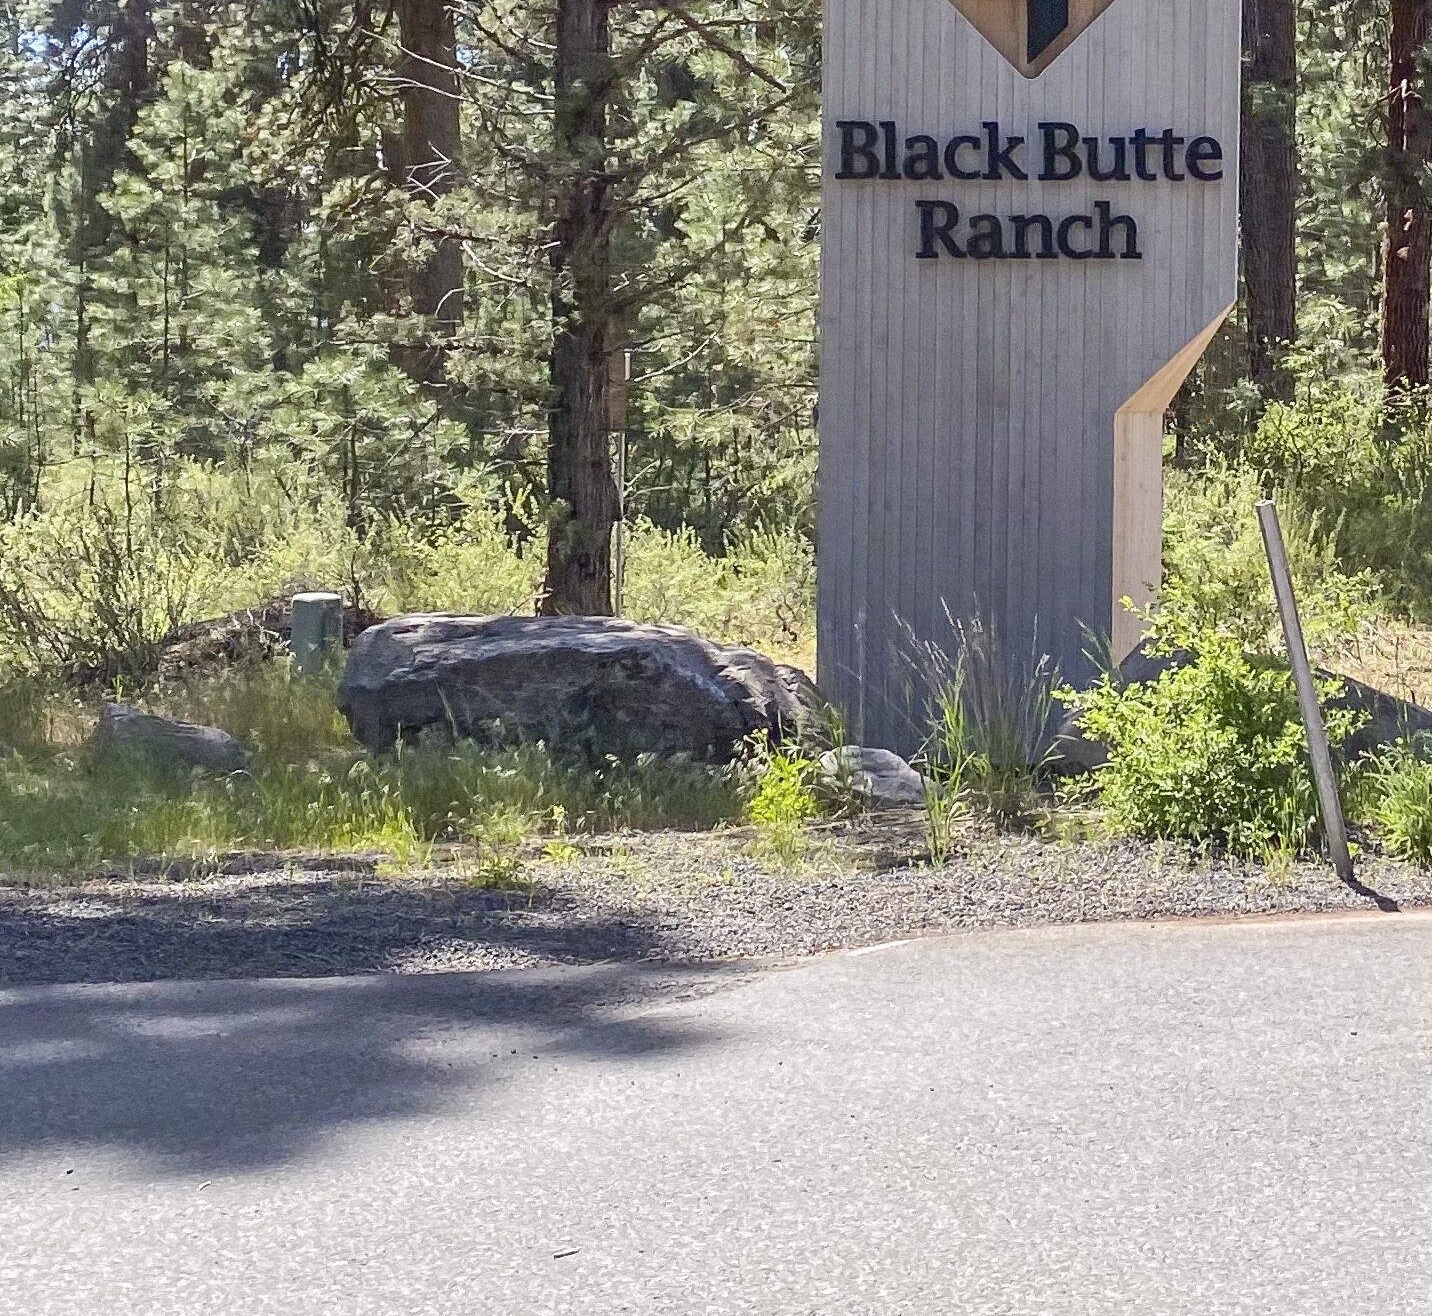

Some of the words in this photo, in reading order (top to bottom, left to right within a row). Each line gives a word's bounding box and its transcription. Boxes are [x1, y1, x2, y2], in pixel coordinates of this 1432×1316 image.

[835, 120, 1028, 180] Black
[1037, 121, 1224, 181] Butte
[915, 199, 1142, 259] Ranch
